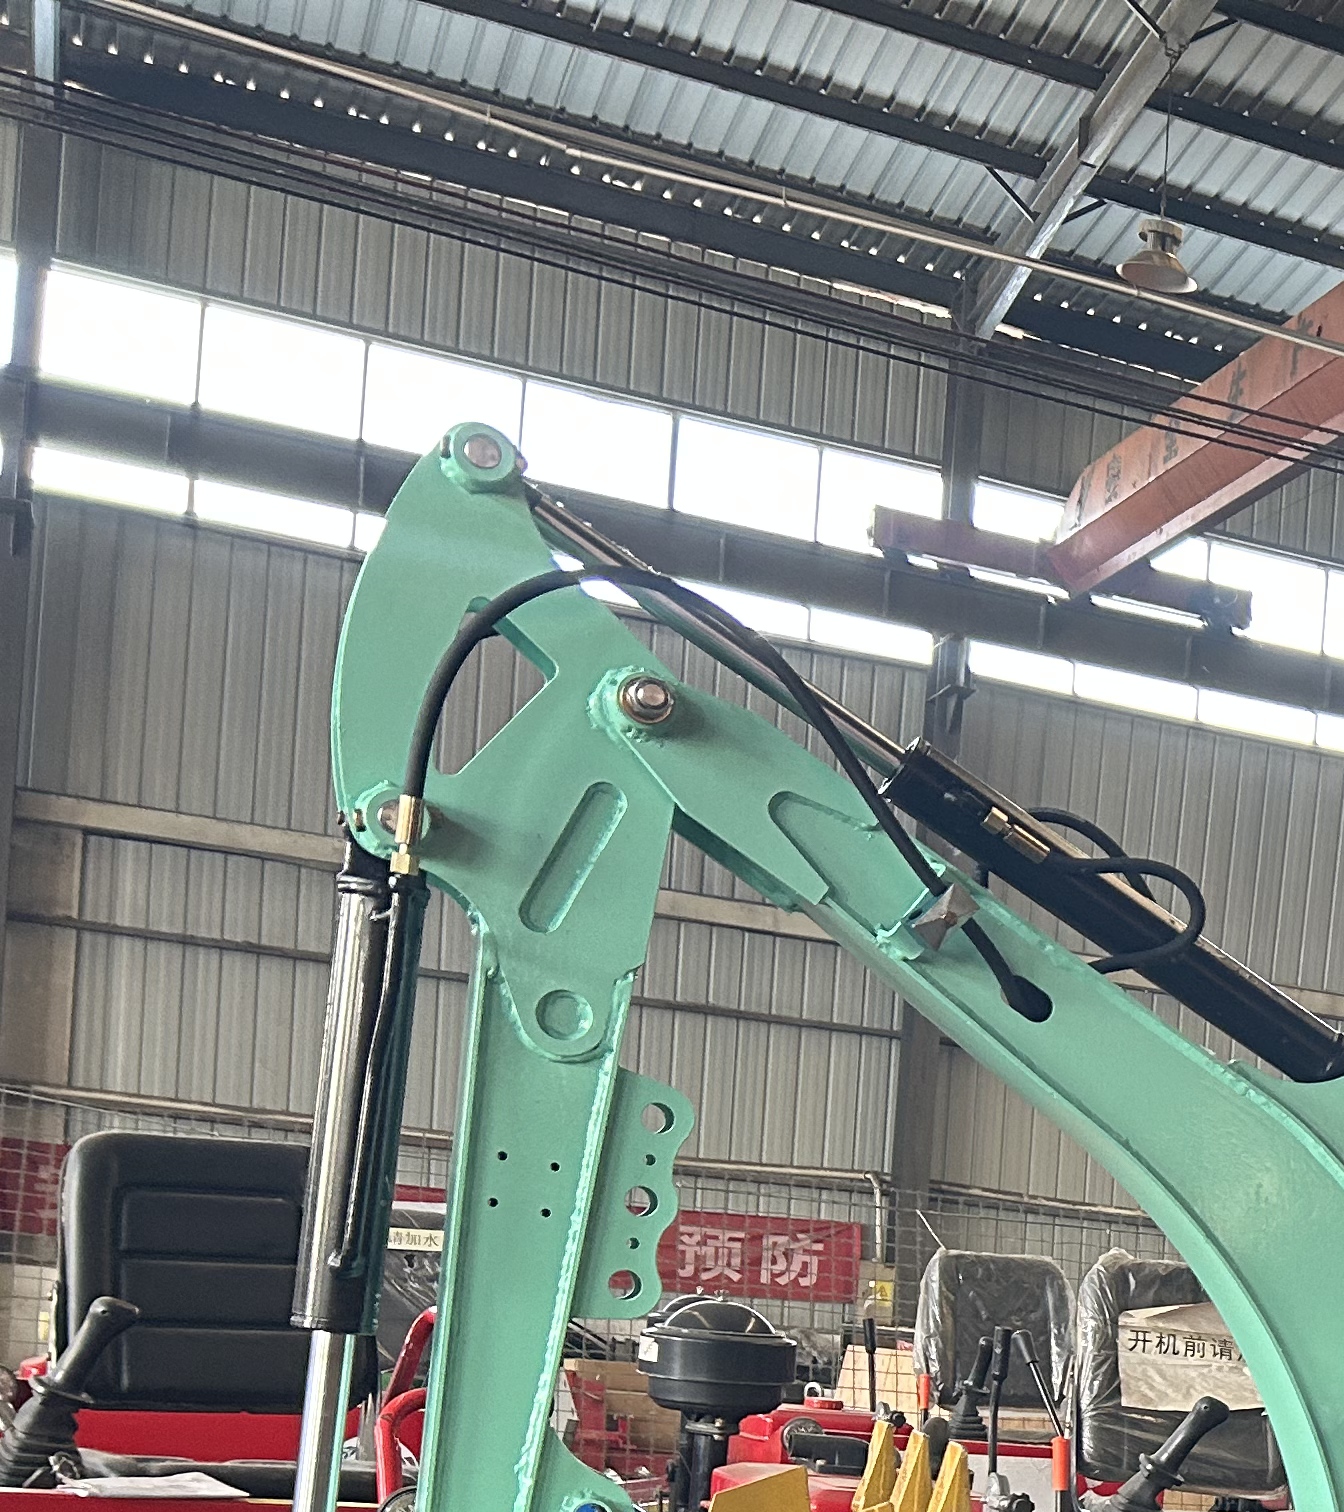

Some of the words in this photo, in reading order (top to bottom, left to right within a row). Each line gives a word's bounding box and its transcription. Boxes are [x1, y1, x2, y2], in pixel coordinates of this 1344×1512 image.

[677, 1225, 824, 1287] 预防
[1128, 1328, 1247, 1362] 开机前请
